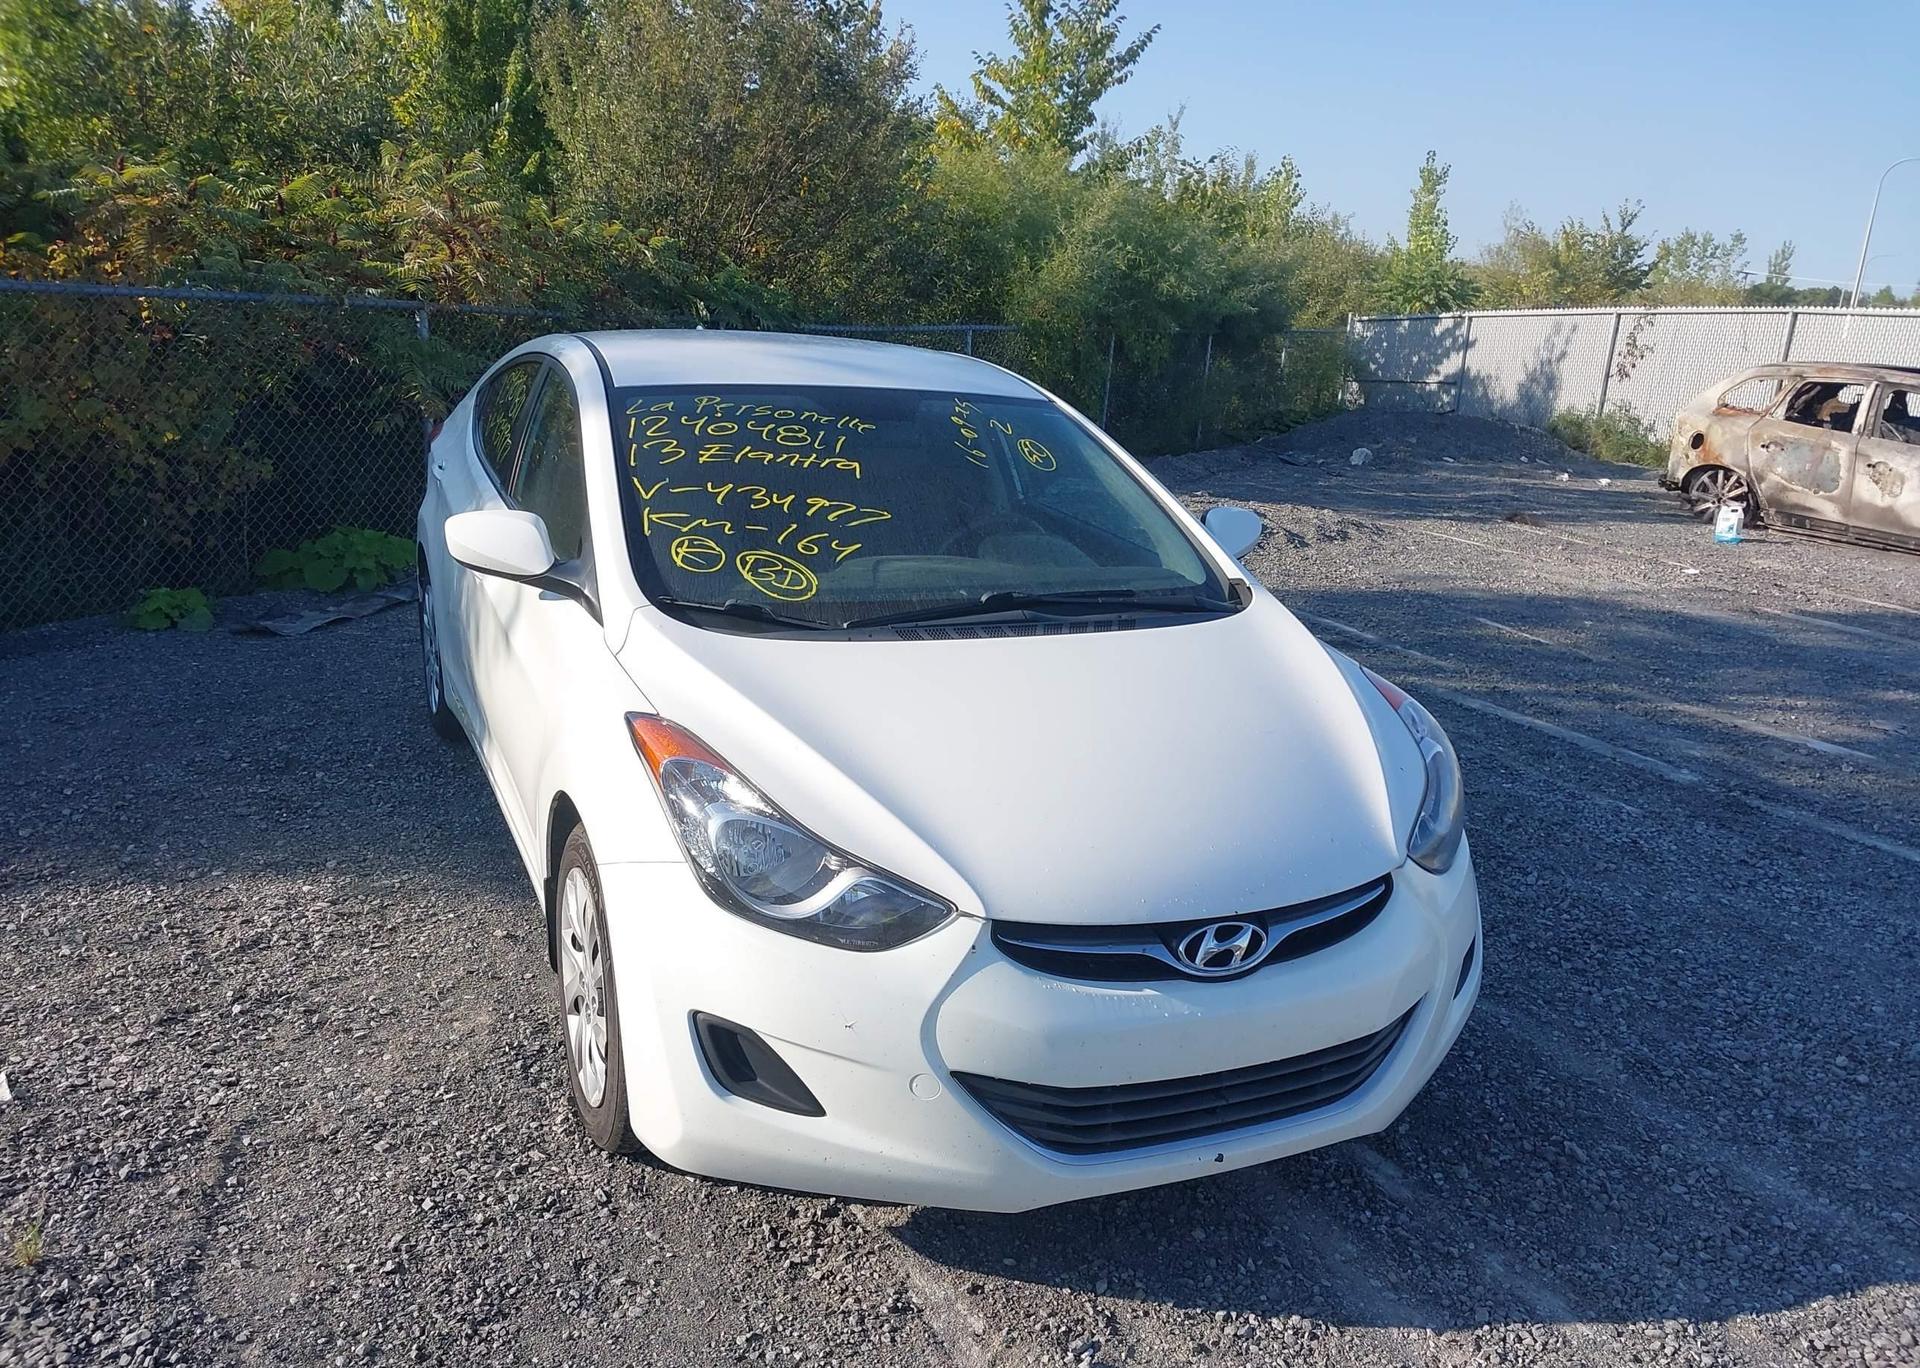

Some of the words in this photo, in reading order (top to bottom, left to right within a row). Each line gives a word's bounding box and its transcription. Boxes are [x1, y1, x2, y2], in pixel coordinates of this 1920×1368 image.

[628, 416, 847, 454] 12404811
[629, 439, 686, 466] 13
[699, 444, 861, 479] Elantra
